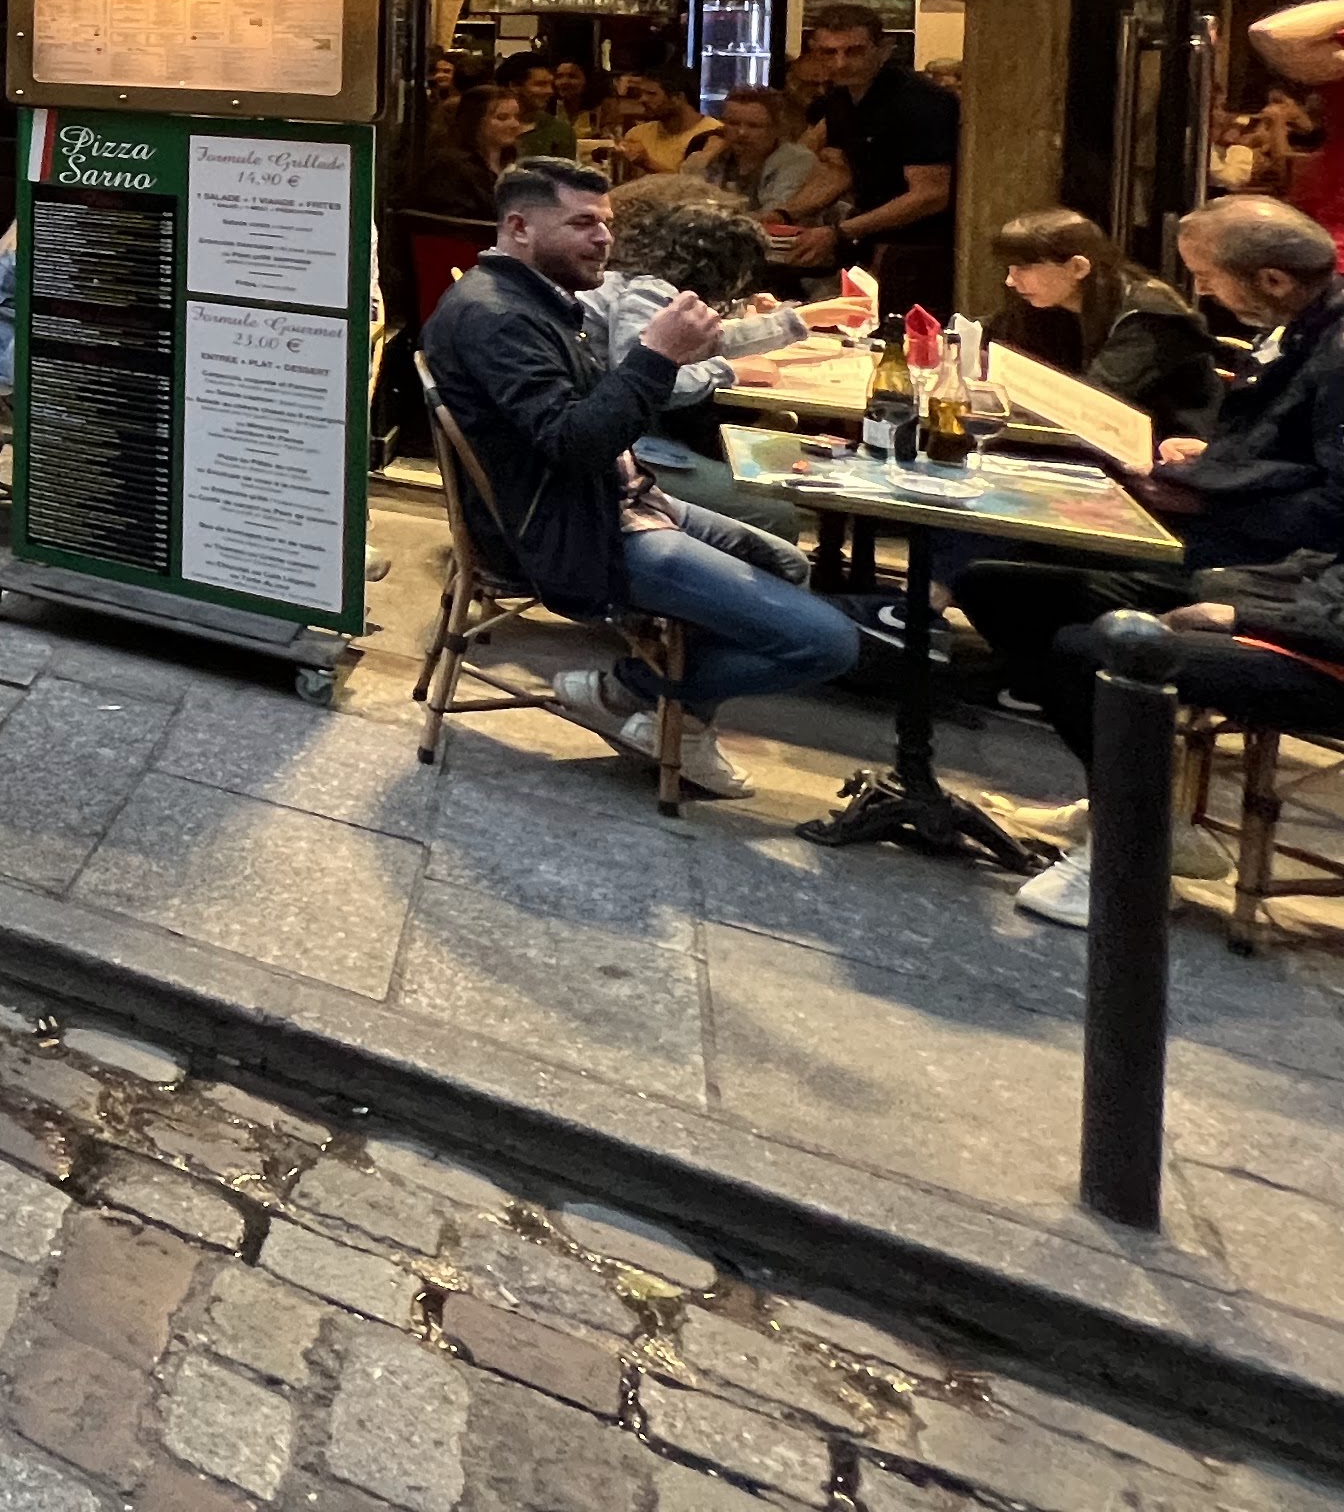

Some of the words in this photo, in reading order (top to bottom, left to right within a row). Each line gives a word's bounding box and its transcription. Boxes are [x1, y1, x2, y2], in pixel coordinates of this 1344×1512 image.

[59, 125, 157, 160] Pizza
[58, 153, 158, 190] Sarno
[203, 192, 241, 203] SALADE
